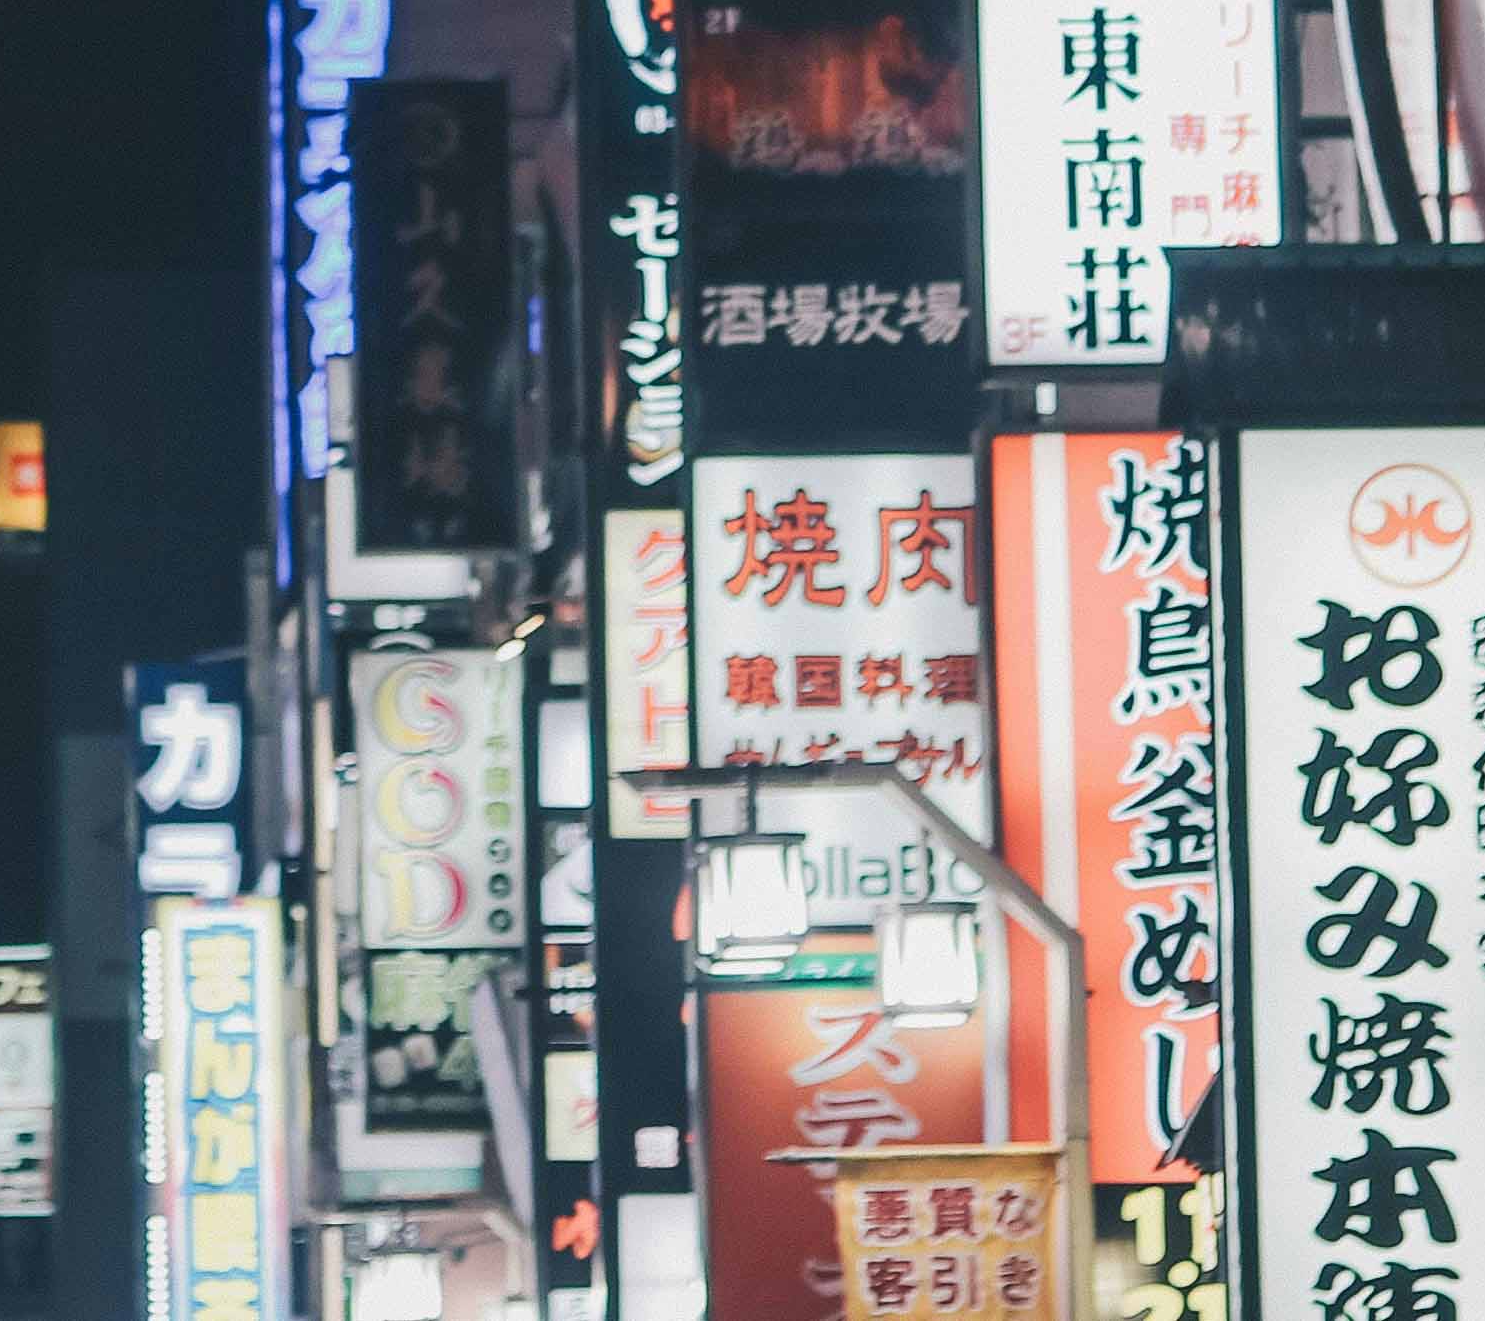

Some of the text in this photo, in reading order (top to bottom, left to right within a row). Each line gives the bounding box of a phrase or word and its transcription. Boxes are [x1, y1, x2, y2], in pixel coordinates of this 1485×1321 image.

[1058, 7, 1150, 350] 東南荘
[724, 488, 979, 608] 焼肉
[725, 654, 979, 711] 韓国料理
[860, 1185, 1042, 1245] 悪質な
[862, 1254, 1042, 1314] 客引き
